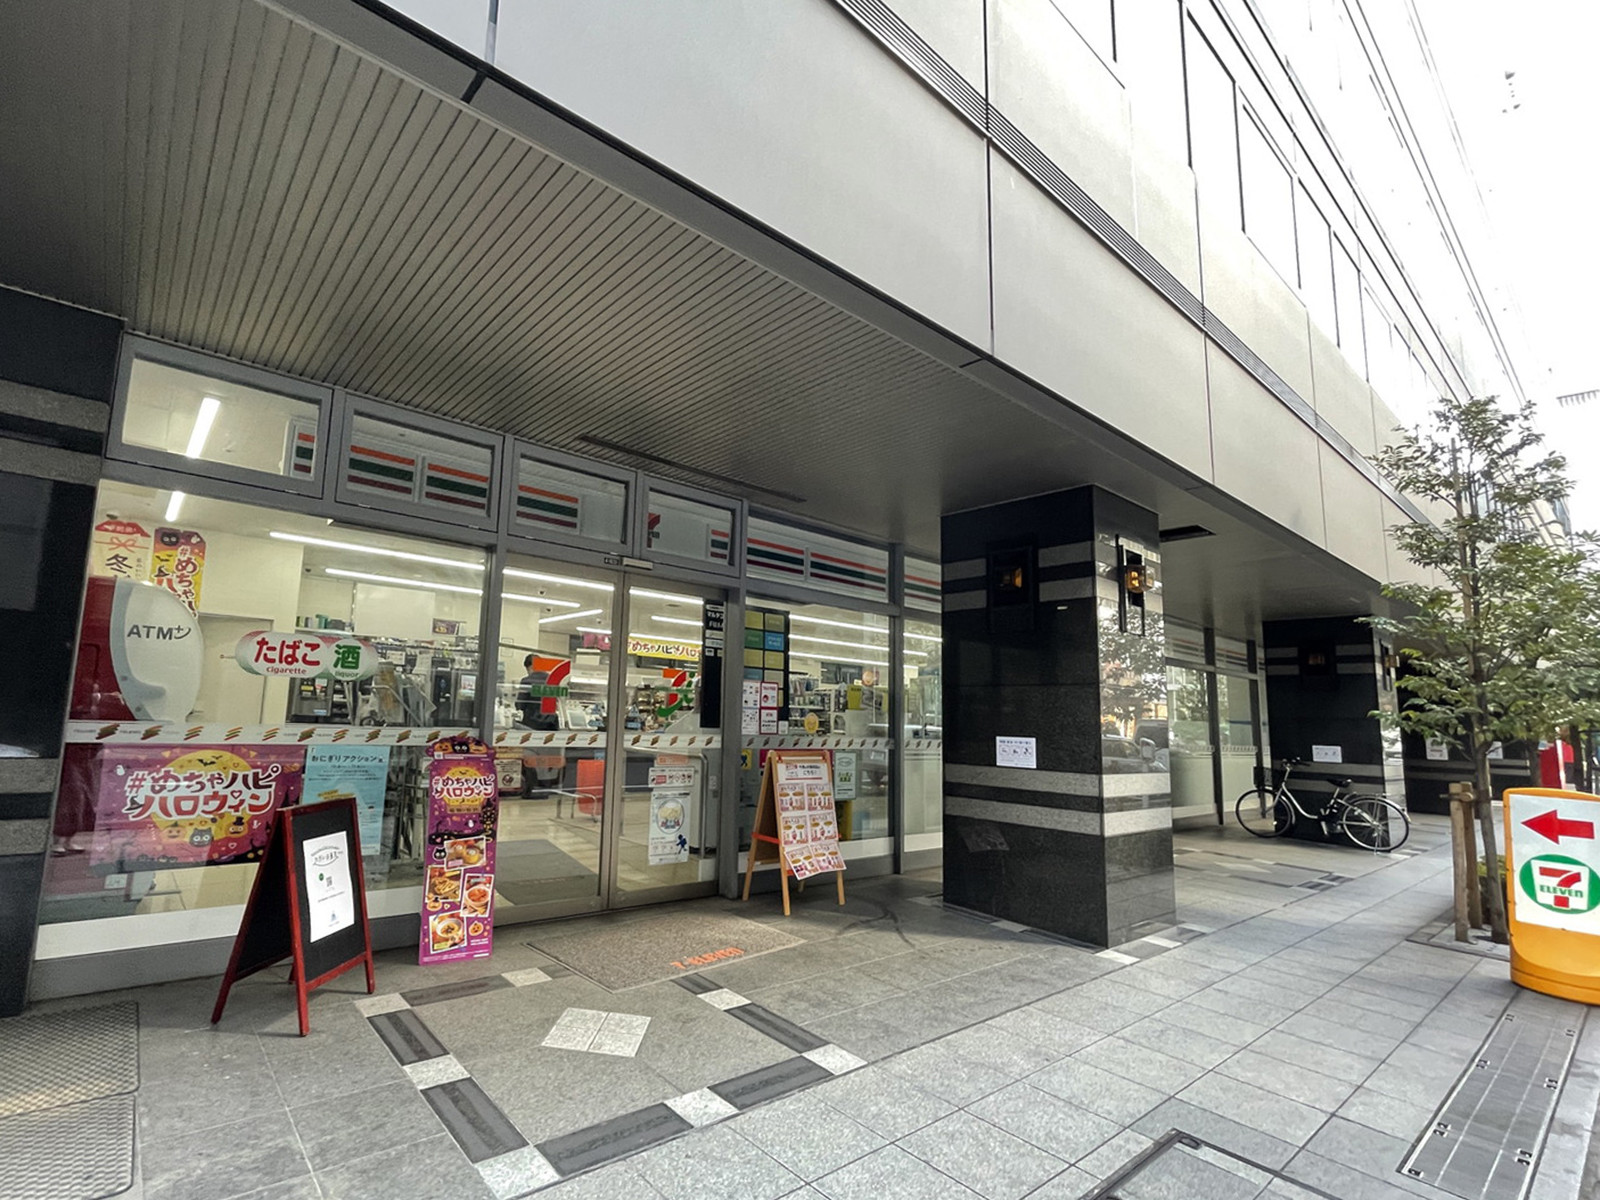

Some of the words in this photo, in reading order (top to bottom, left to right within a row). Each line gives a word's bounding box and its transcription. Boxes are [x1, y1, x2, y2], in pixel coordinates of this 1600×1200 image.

[105, 553, 133, 578] 冬
[254, 637, 321, 666] たばこ
[333, 643, 361, 670] 酒
[266, 666, 307, 675] cigarette
[335, 670, 359, 679] liquor
[126, 765, 281, 795] #めちゃハピ
[131, 790, 274, 819] ハロウィン
[1539, 866, 1582, 908] 7
